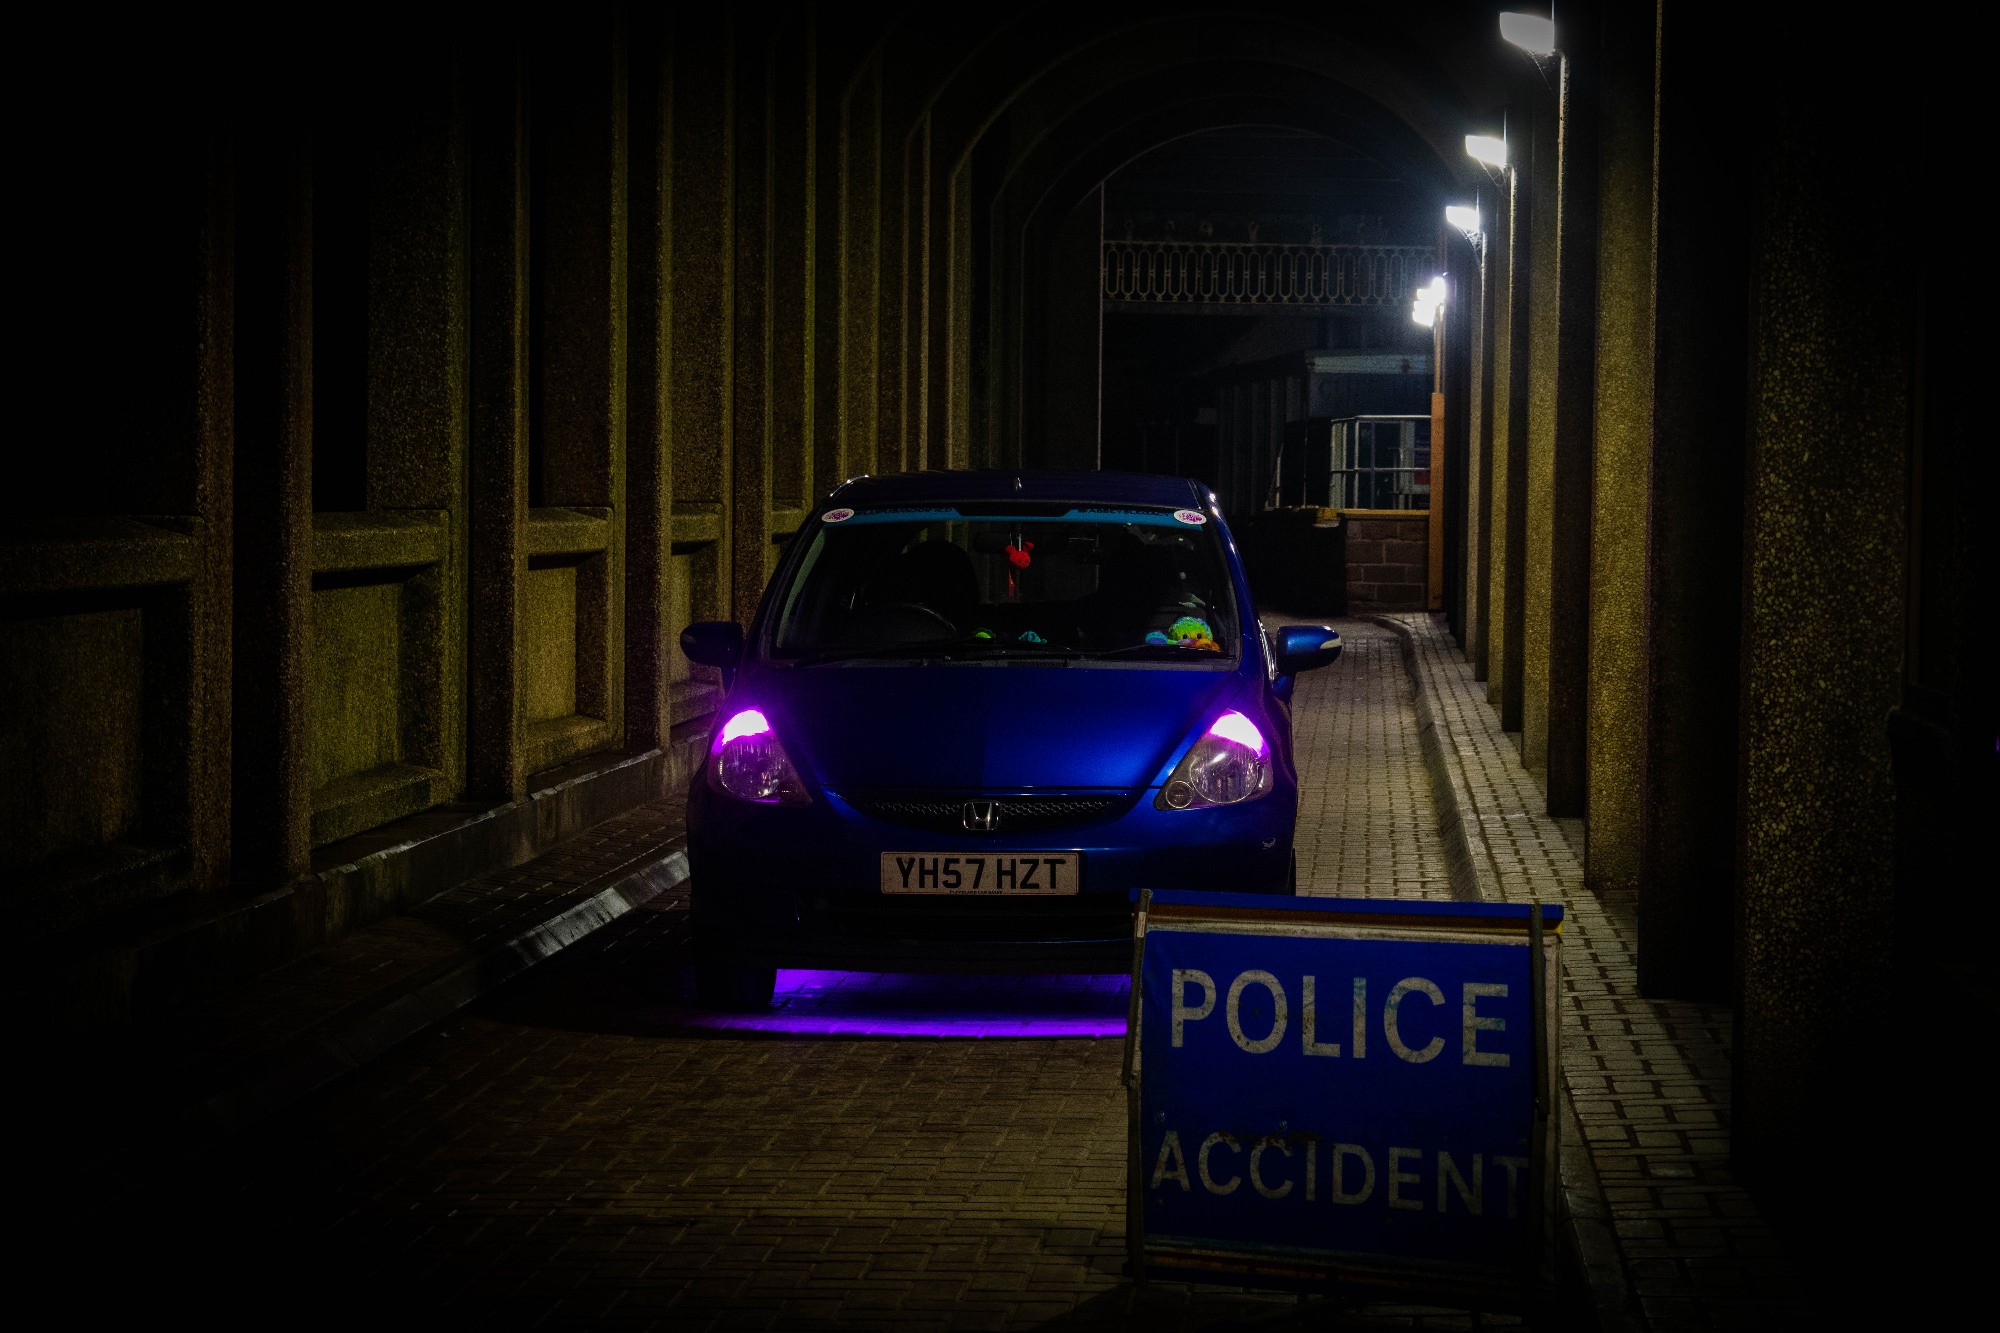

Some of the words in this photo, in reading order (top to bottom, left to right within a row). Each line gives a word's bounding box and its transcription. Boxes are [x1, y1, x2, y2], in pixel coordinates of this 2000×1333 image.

[896, 857, 985, 889] YH57
[996, 858, 1066, 889] HZT
[1171, 968, 1511, 1068] POLICE
[1150, 1130, 1530, 1221] ACCIDENT
